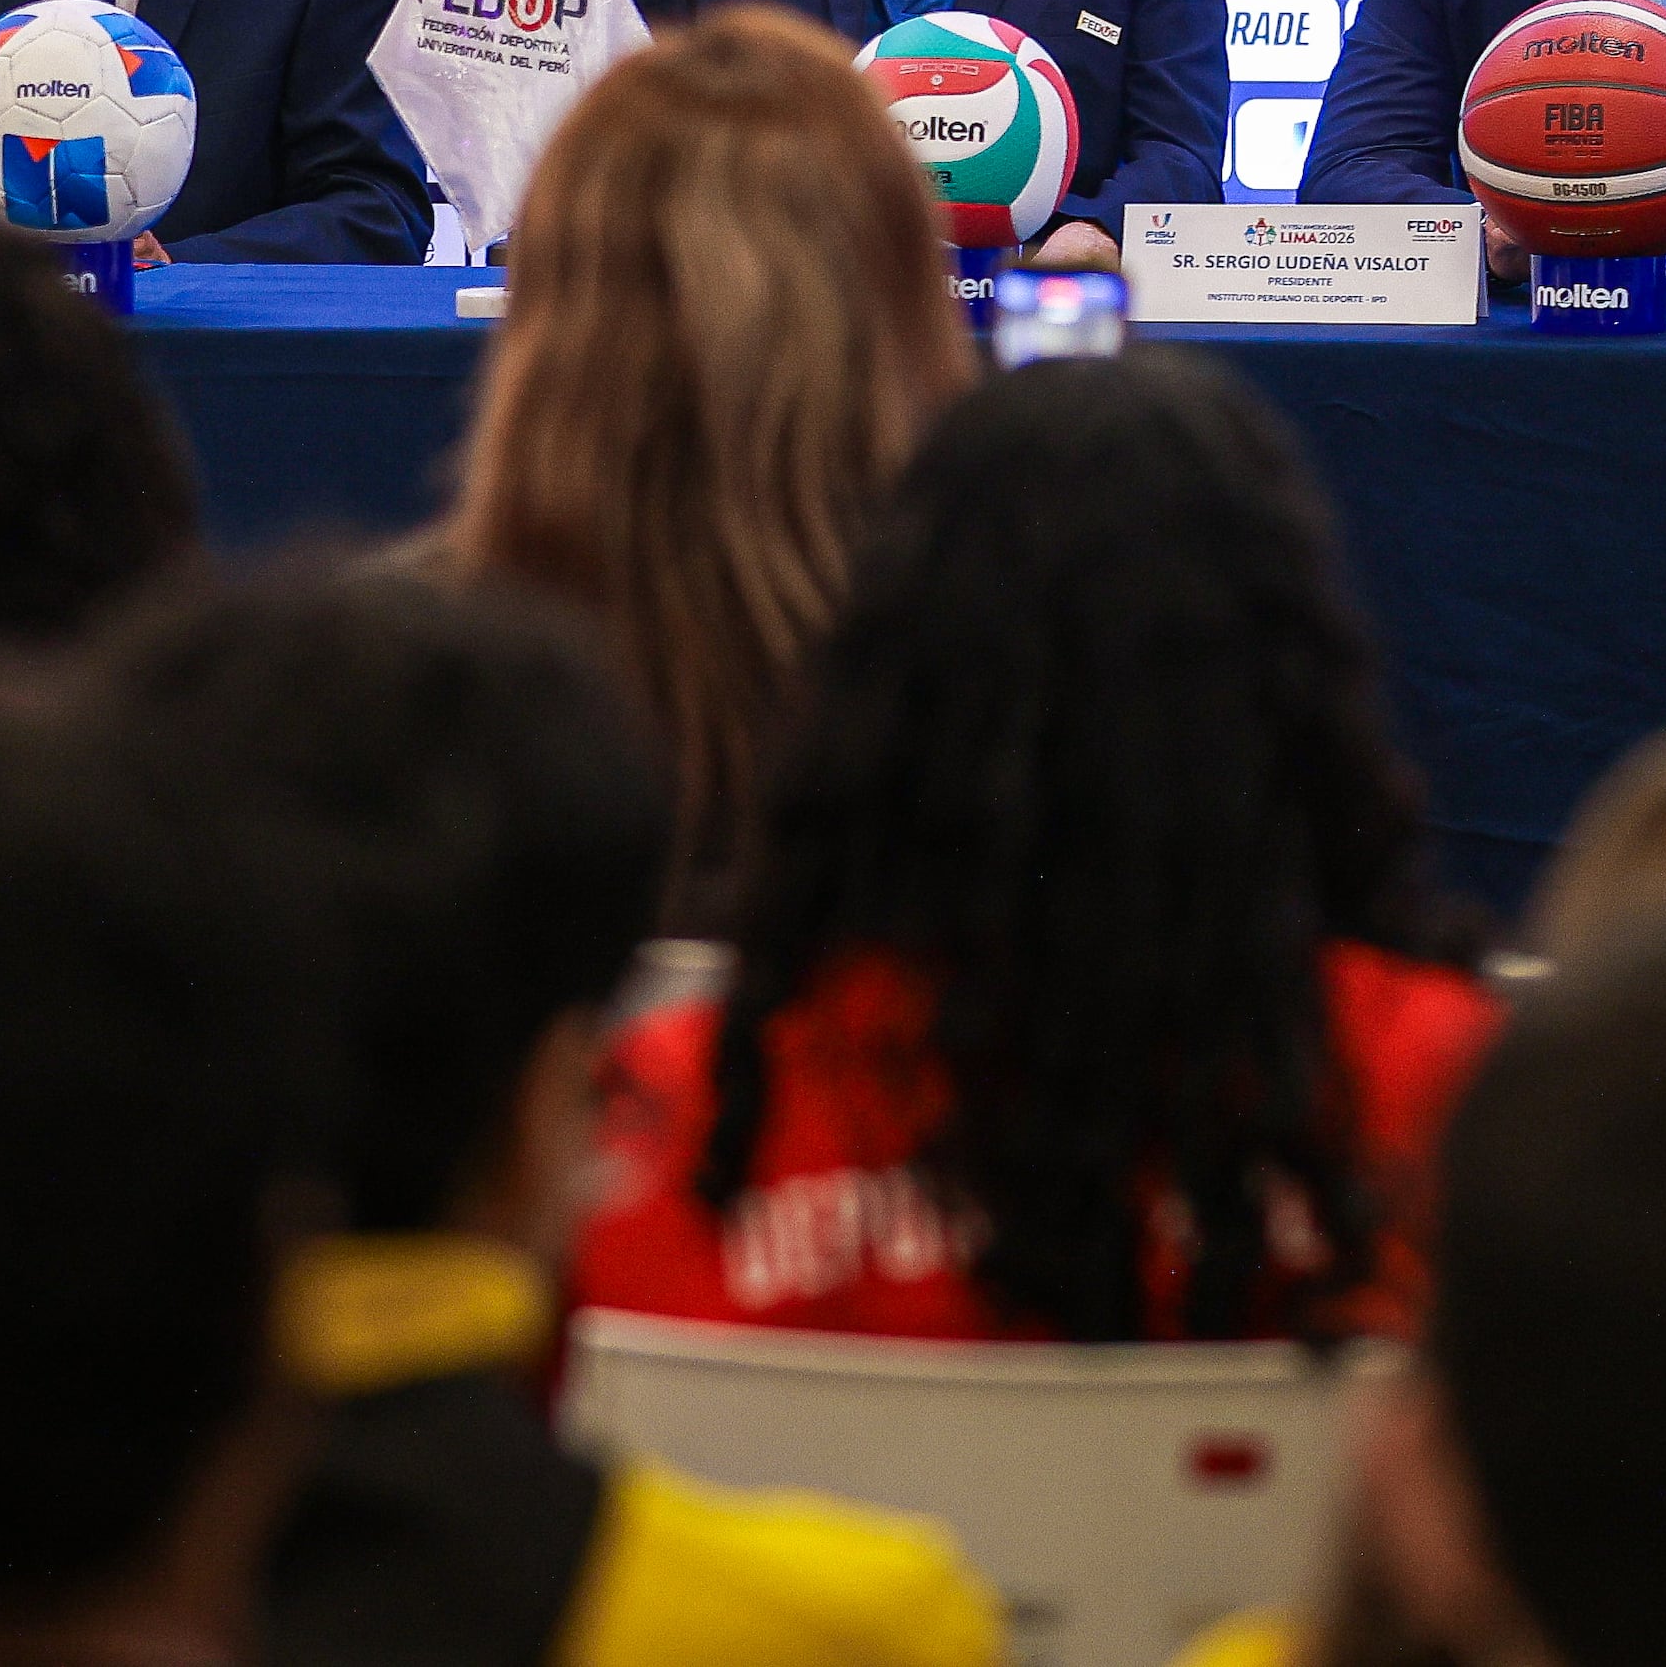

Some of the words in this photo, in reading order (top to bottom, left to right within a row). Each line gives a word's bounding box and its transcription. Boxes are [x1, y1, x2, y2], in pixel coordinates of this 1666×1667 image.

[1523, 33, 1645, 63] molten
[510, 55, 533, 69] DEL
[17, 79, 91, 99] molten
[1545, 103, 1604, 131] FIBA
[1319, 232, 1356, 244] 2026
[1172, 254, 1200, 269] SR.
[1205, 255, 1271, 270] SERGIO
[1276, 253, 1349, 271] LUDEÑA
[1354, 257, 1430, 272] VISALOT
[1267, 276, 1333, 287] PRESIDENTE
[1536, 283, 1629, 310] molten
